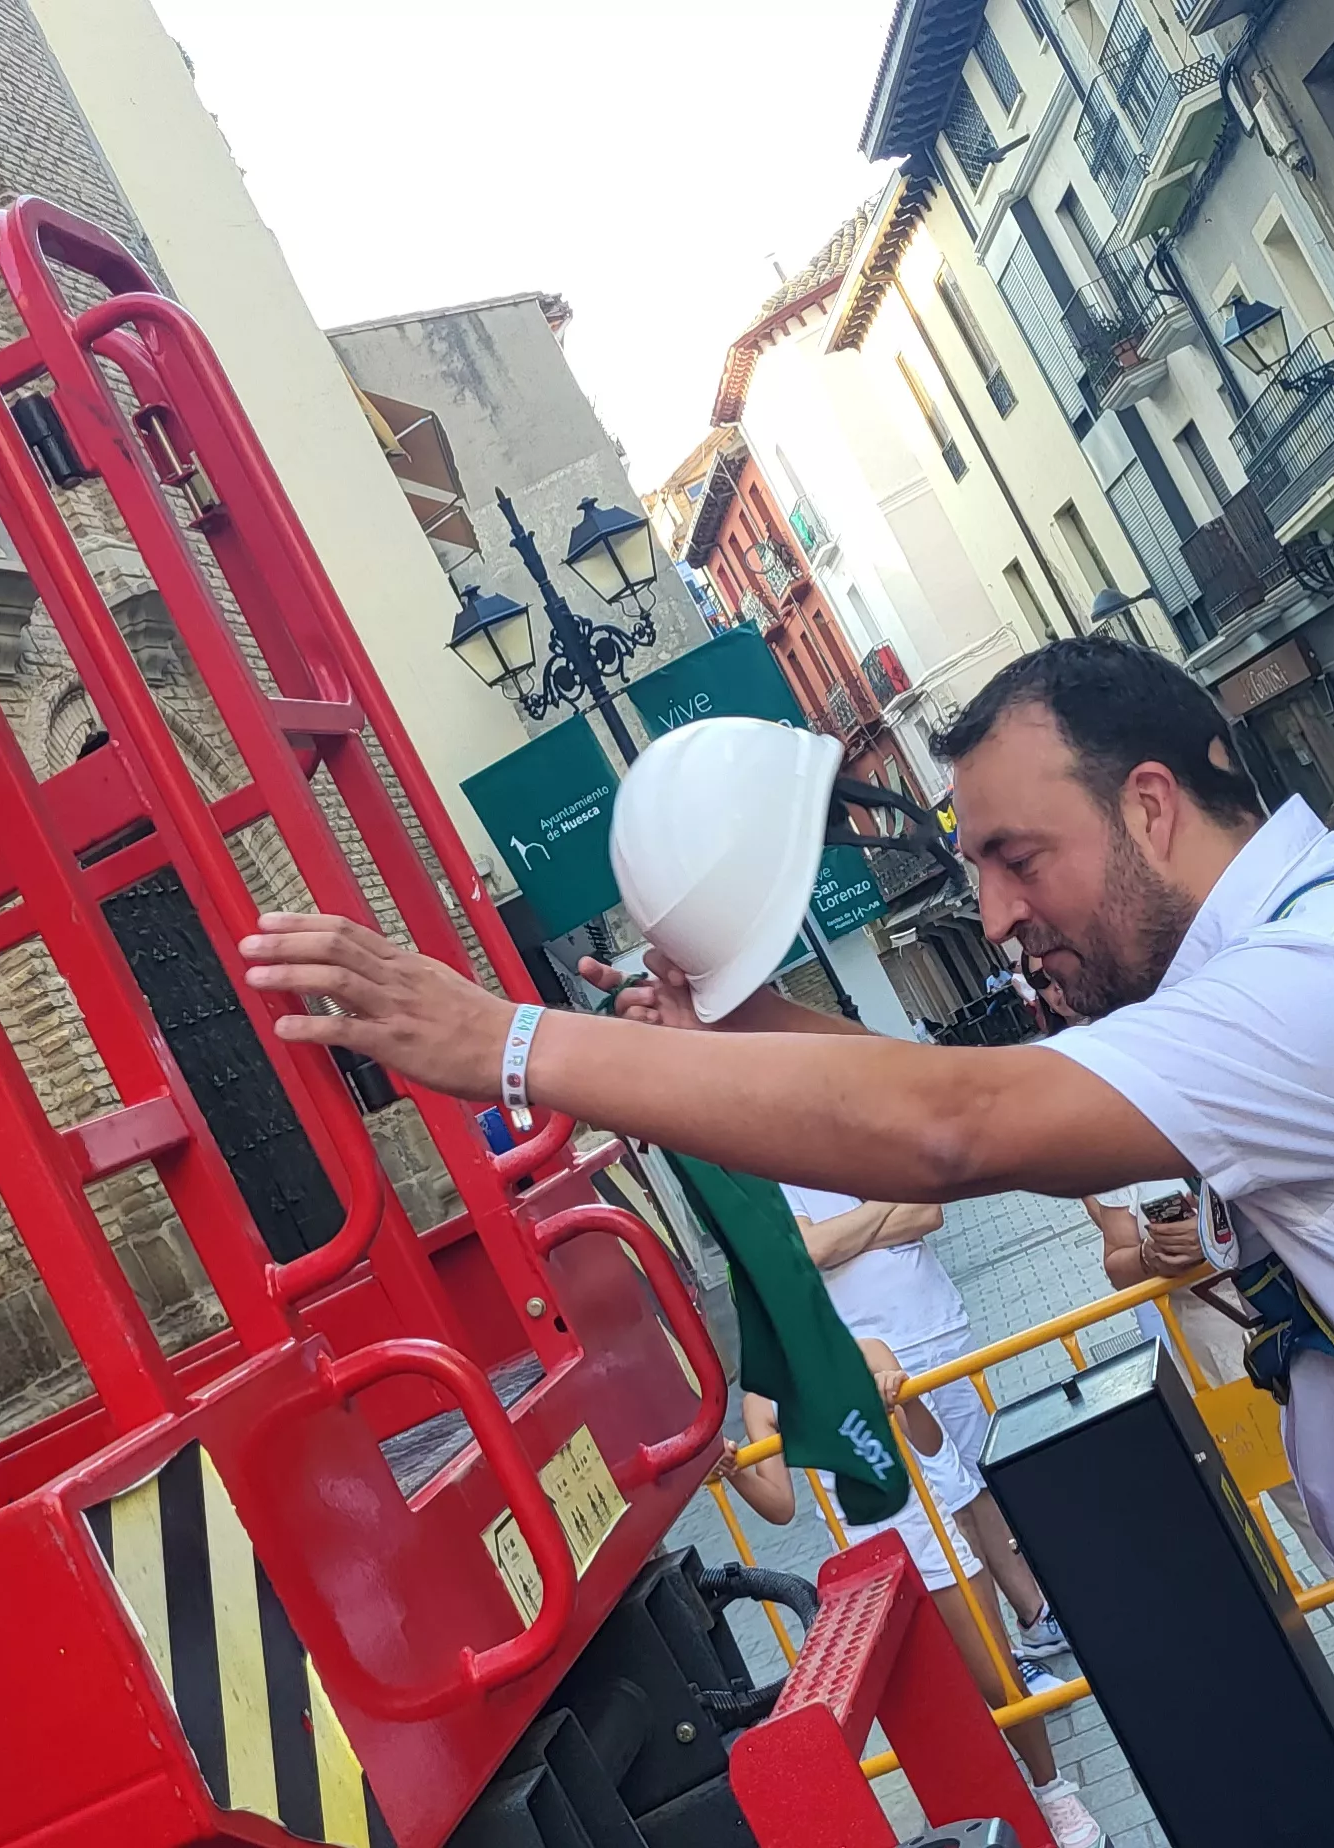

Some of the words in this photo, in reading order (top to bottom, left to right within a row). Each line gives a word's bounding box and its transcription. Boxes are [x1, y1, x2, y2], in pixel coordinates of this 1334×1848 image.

[658, 692, 713, 730] vive
[540, 785, 610, 831] Ayuntamiento
[546, 829, 561, 842] de
[560, 806, 601, 833] Huesca
[811, 880, 839, 899] San
[816, 867, 833, 881] ve
[816, 880, 871, 912] Lorenzo
[516, 1008, 539, 1032] 2024
